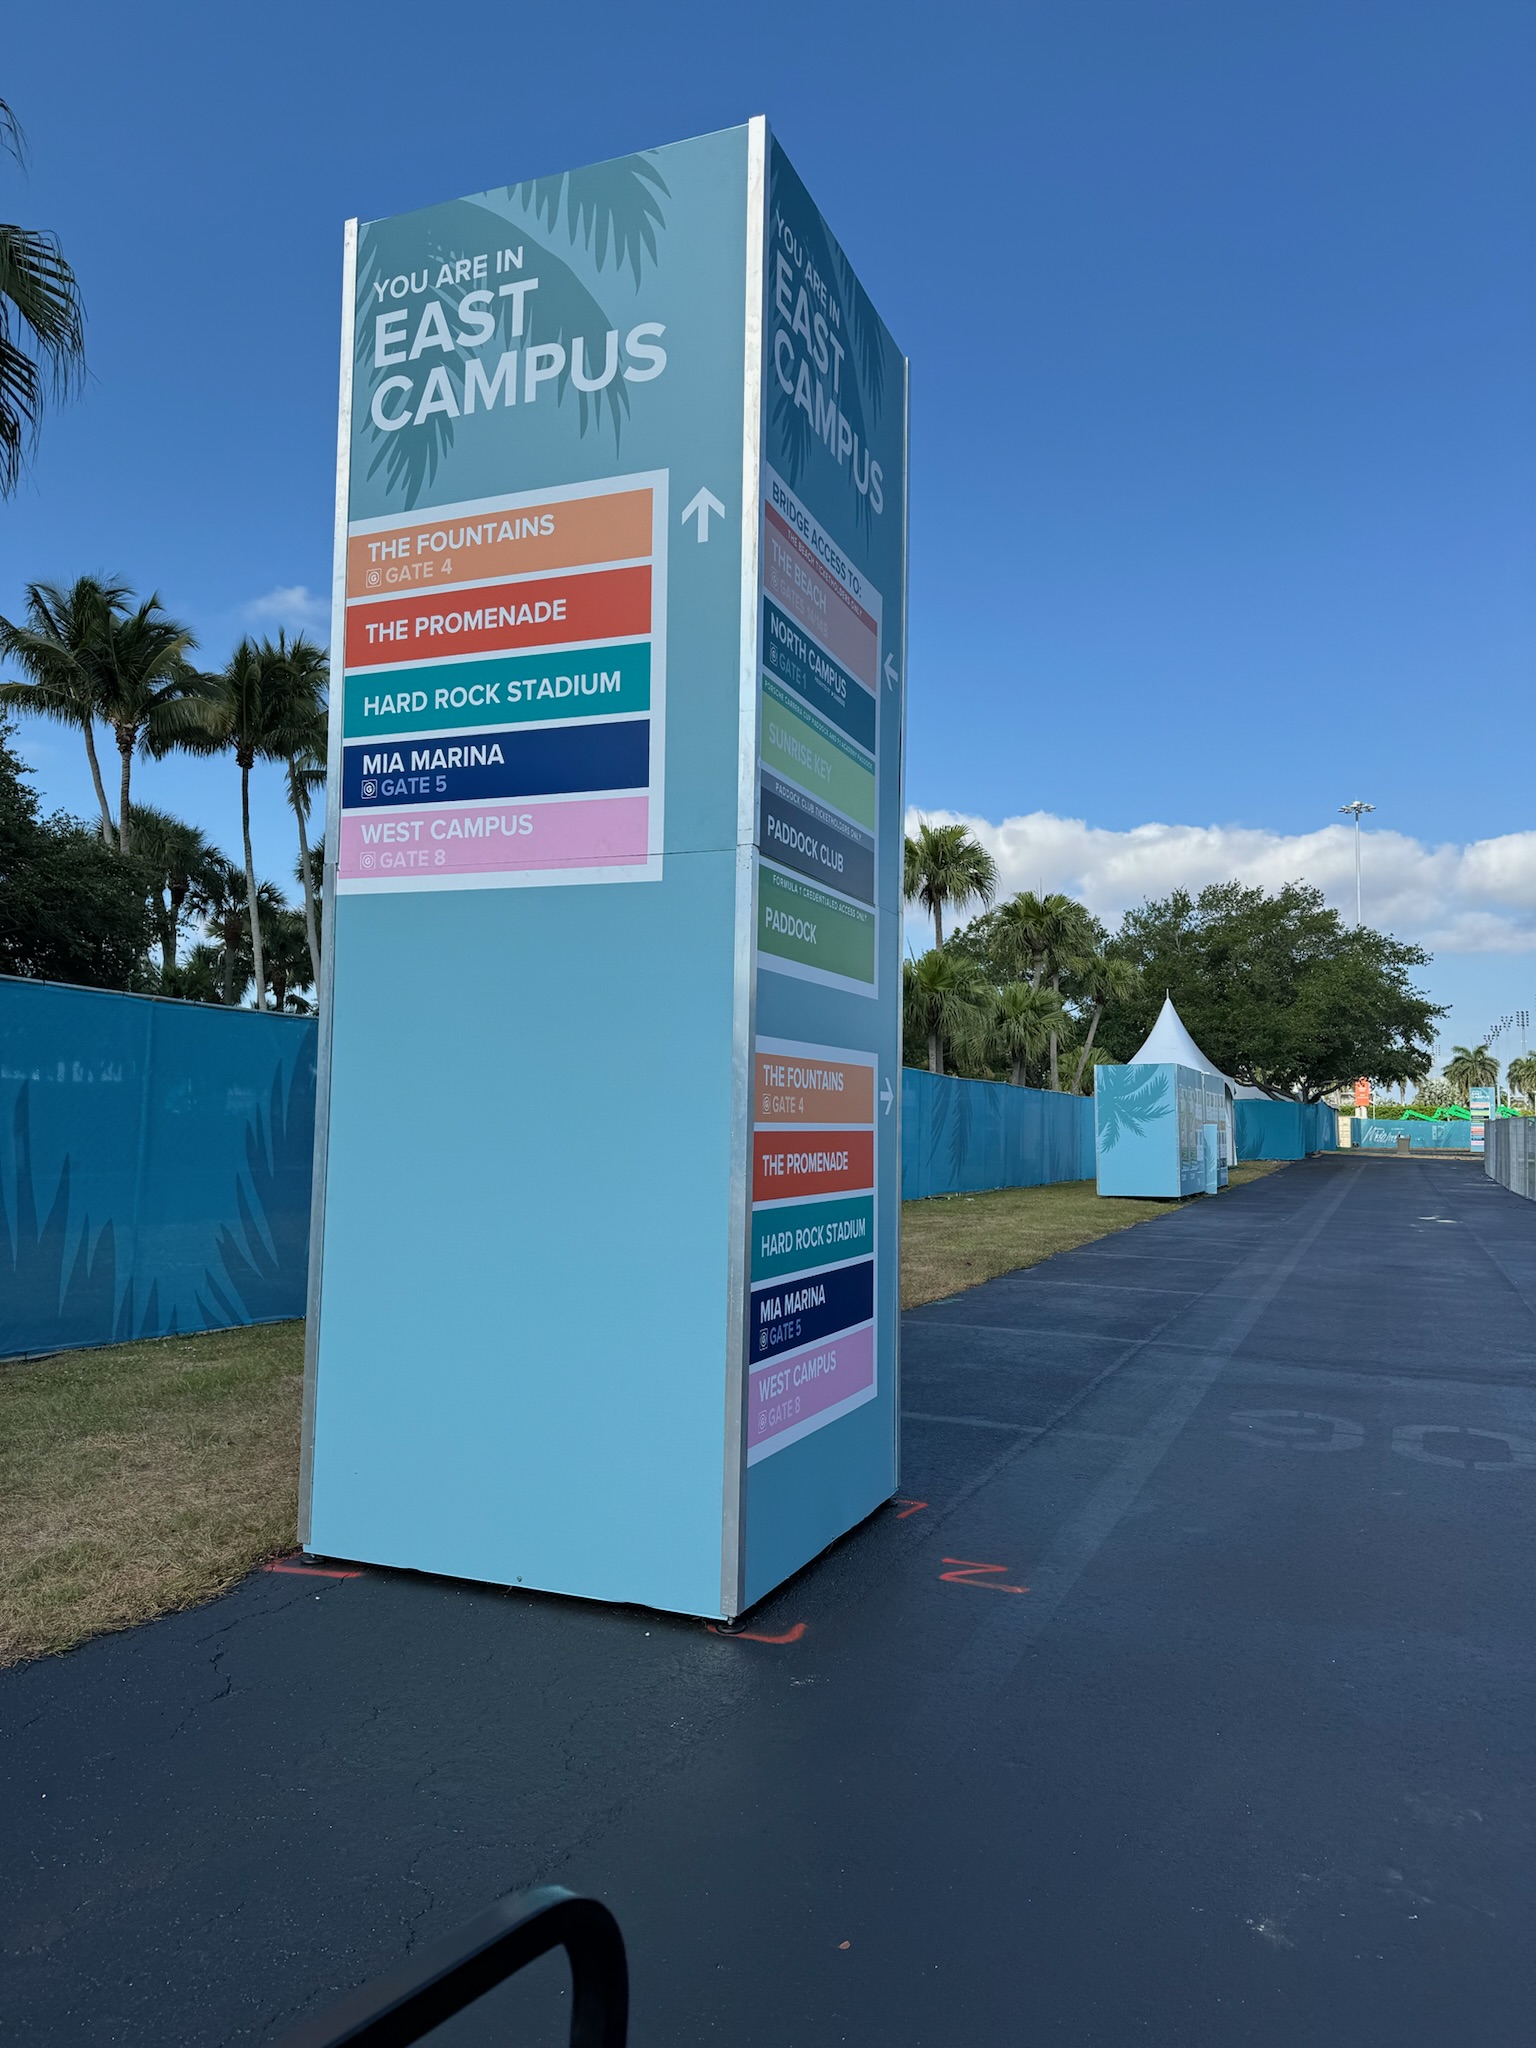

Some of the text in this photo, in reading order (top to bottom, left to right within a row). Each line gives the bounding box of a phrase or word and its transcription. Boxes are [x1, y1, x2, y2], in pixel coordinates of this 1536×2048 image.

[373, 246, 523, 303] YOU ARE IN
[775, 209, 840, 329] YOU ARE IN
[374, 278, 539, 369] EAST
[776, 249, 845, 394] EAST
[371, 322, 667, 431] CAMPUS
[774, 329, 884, 515] CAMPUS
[368, 514, 555, 562] THE FOUNTAINS
[772, 481, 809, 539] BRIDGE
[811, 531, 846, 581] ACCESS
[788, 530, 798, 547] THE
[798, 543, 815, 566] BEACH
[386, 558, 452, 584] GATE 4
[771, 539, 827, 614] THE BEACH
[780, 580, 805, 614] GATES
[366, 599, 566, 644] THE PROMENADE
[770, 612, 807, 664] NORTH
[808, 649, 847, 699] CAMPUS
[779, 652, 801, 683] GATE
[364, 671, 621, 716] HARD ROCK STADIUM
[764, 680, 784, 700] PORSCHE
[363, 744, 504, 775] MIA MARINA
[769, 722, 832, 783] SUNRISE KEY
[381, 775, 447, 796] GATE 5
[775, 782, 800, 806] PADDOCK
[802, 799, 814, 813] CLUB
[361, 814, 533, 844] WEST CAMPUS
[768, 815, 844, 873] PADDOCK CLUB
[380, 849, 446, 869] GATE 8
[773, 875, 798, 893] FORMULA
[802, 887, 838, 911] CREDENTIALED
[838, 904, 856, 918] ACCESS
[765, 906, 817, 944] PADDOCK
[763, 1065, 844, 1091] THE FOUNTAINS
[772, 1096, 804, 1114] GATE 4
[762, 1151, 848, 1176] THE PROMENADE
[761, 1218, 866, 1257] HARD ROCK STADIUM
[760, 1284, 826, 1323] MIA MARINA
[769, 1318, 802, 1346] GATE 5
[759, 1351, 837, 1402] WEST CAMPUS
[768, 1396, 801, 1427] GATE 8
